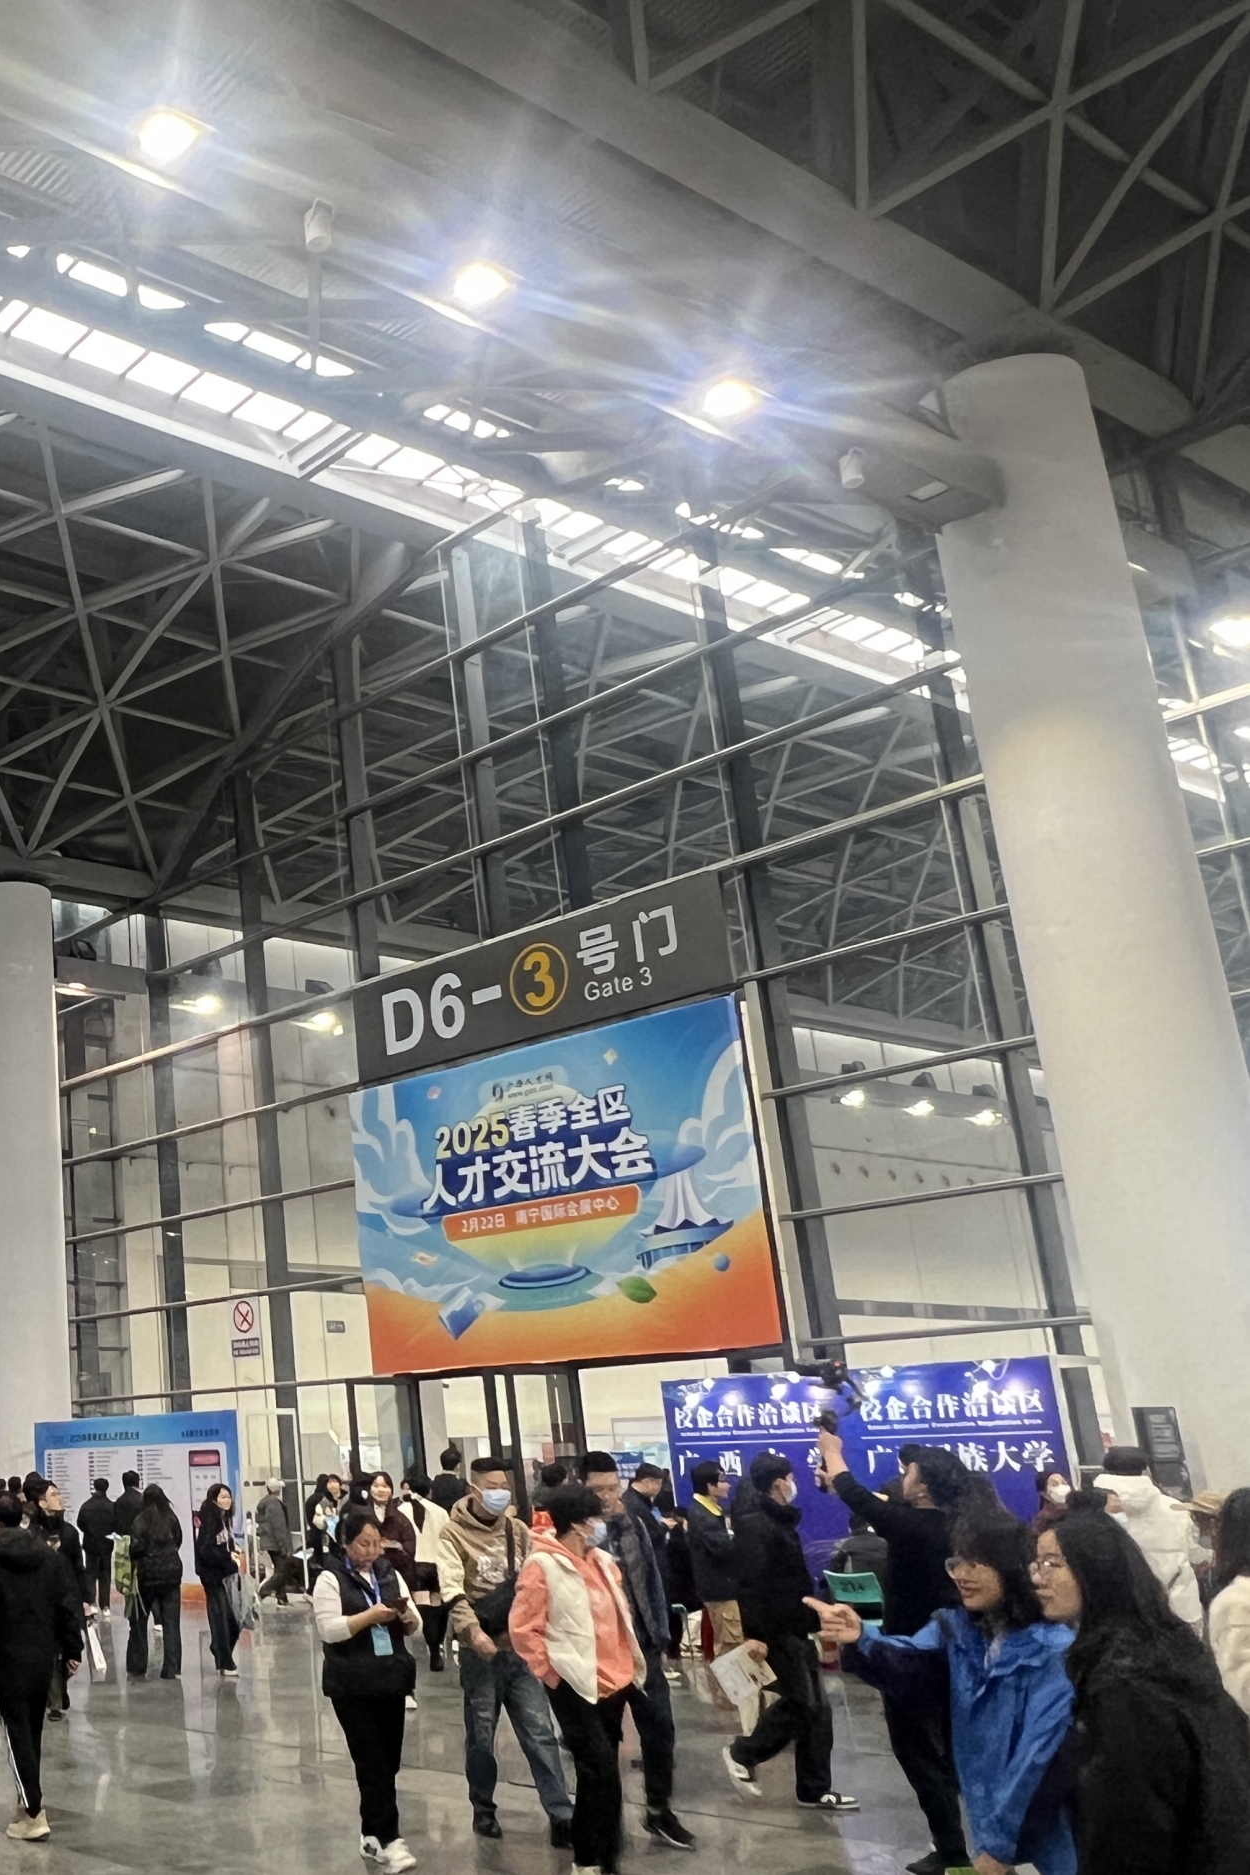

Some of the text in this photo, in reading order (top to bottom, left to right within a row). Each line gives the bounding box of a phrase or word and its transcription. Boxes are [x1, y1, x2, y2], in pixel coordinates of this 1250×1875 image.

[584, 967, 653, 1001] Gate 3
[435, 1084, 631, 1160] 2025春季全区
[423, 1127, 653, 1212] 人才交流大会
[461, 1196, 620, 1233] 2月22日 南宁国际会展中心
